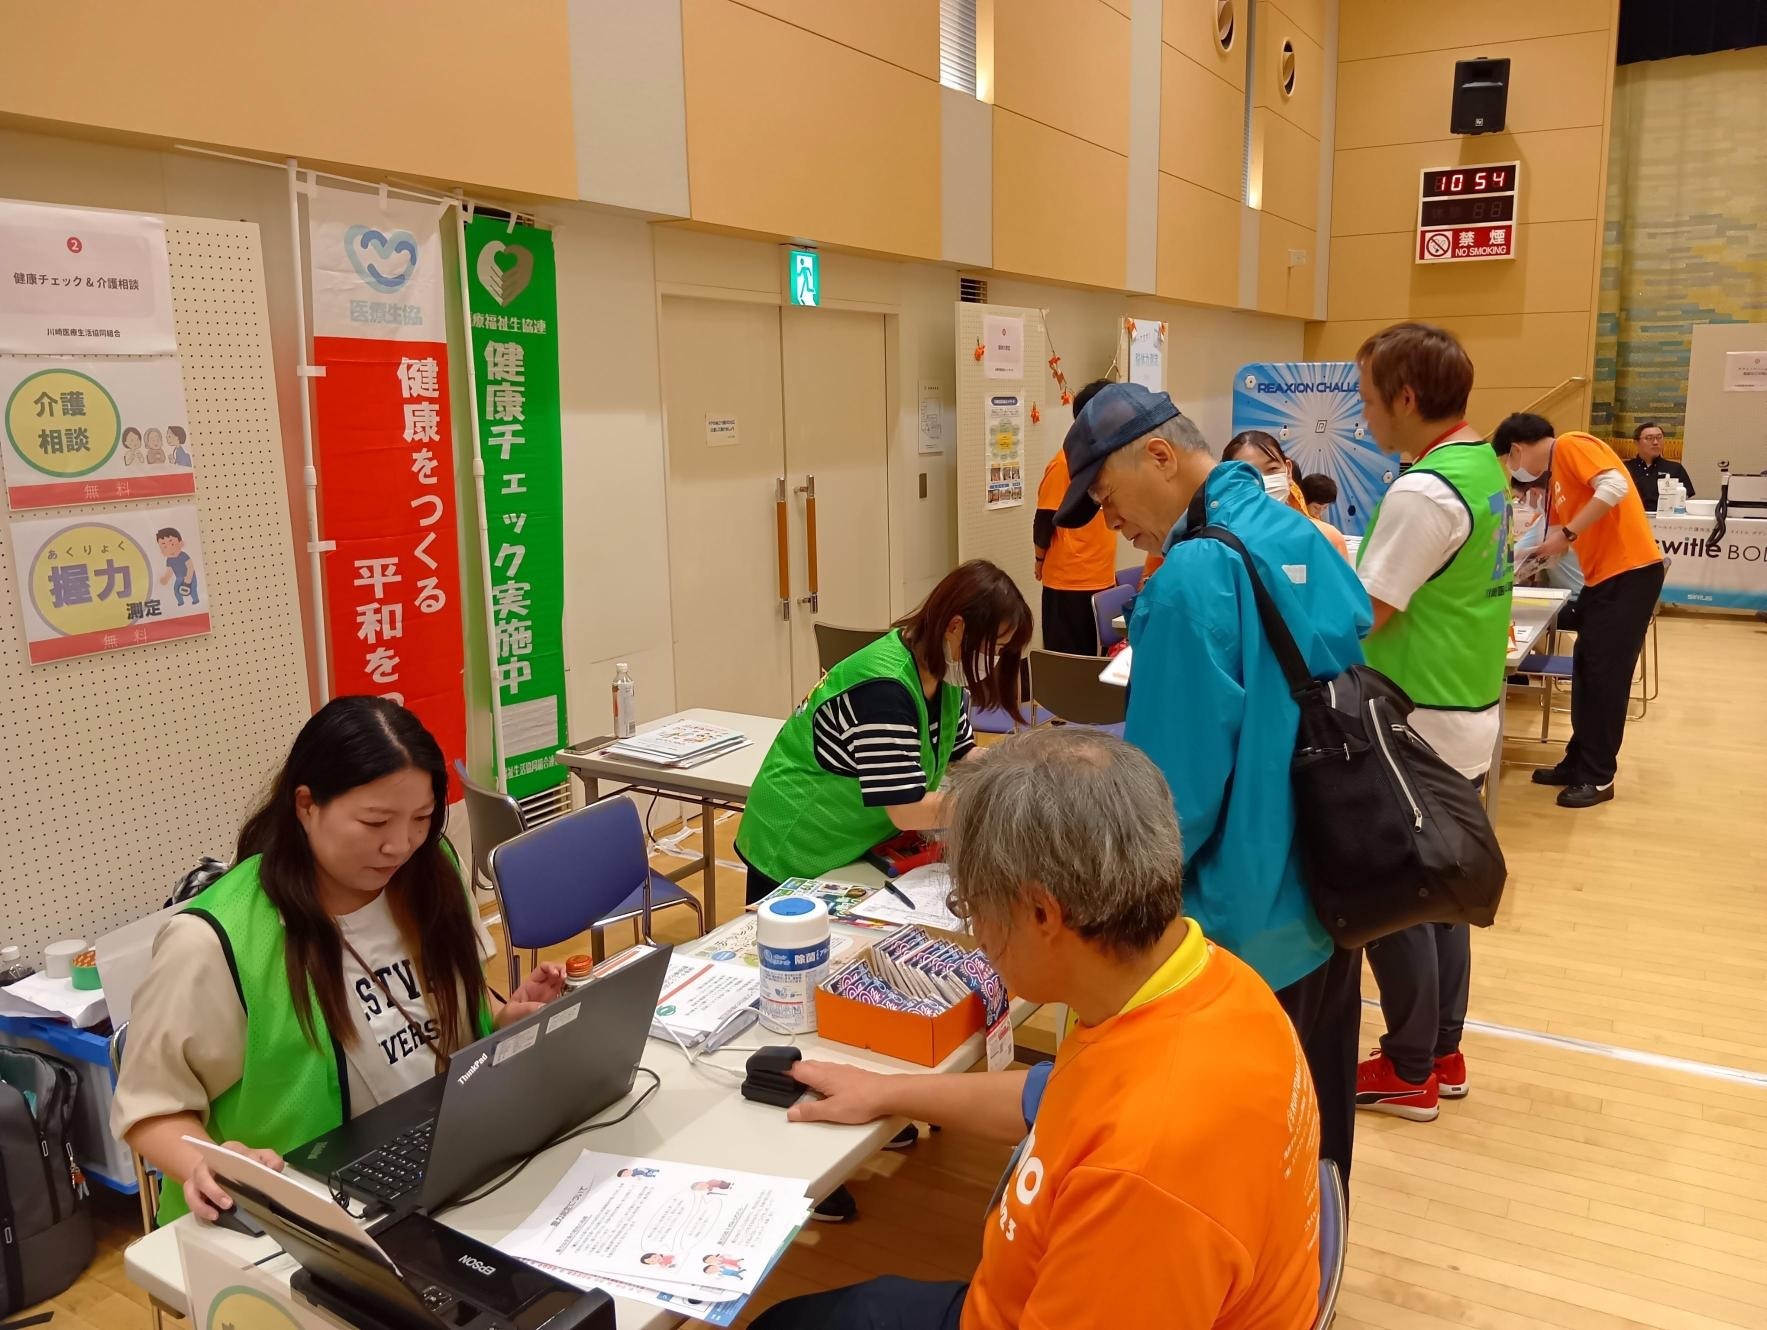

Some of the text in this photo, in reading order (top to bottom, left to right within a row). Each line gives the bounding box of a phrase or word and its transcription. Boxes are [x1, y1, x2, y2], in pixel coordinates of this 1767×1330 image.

[1442, 172, 1505, 191] 10 54
[1458, 229, 1506, 247] 禁煙
[1455, 246, 1507, 257] NO SMOKING
[350, 300, 424, 326] 医療生協
[470, 312, 547, 335] 療福祉生協連
[1257, 383, 1314, 393] REAXION
[33, 391, 87, 418] 介護
[38, 427, 91, 455] 相談
[84, 481, 131, 500] 無料
[396, 356, 447, 614] 健康をつくる
[484, 340, 534, 695] 健康チェック実施中
[47, 540, 126, 561] あくりょく
[47, 558, 133, 609] 握力
[126, 599, 162, 620] 測定
[103, 628, 148, 649] 無料
[457, 1052, 489, 1086] ThinkPad
[458, 1254, 497, 1275] EPSON
